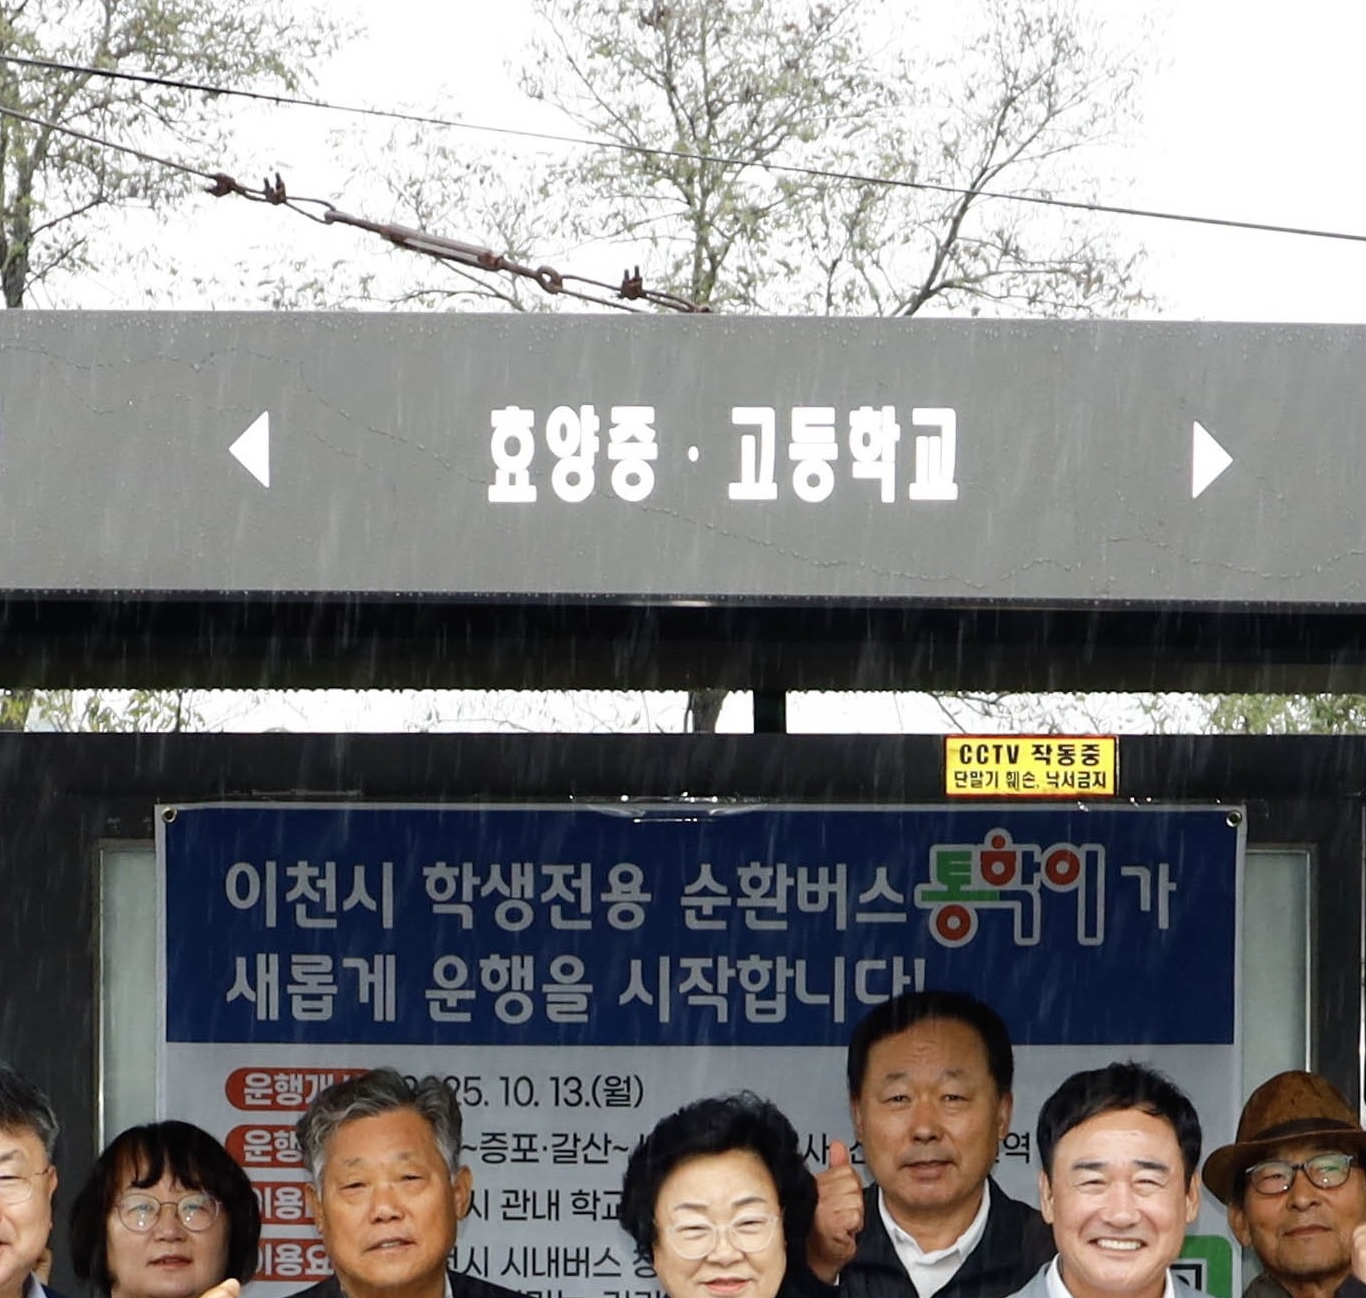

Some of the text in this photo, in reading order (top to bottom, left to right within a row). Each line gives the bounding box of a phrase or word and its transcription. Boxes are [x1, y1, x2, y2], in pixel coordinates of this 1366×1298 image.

[959, 744, 1100, 766] CCTV 작동중
[954, 771, 998, 788] 단말기
[1046, 771, 1106, 789] 낙서금지
[225, 828, 1177, 947] 이천시 학생전용 순환버스 통학이 가
[226, 953, 396, 1022] 새롭게
[425, 953, 594, 1025] 운행을
[243, 1072, 351, 1106] 운행개
[499, 1075, 539, 1107] 10.
[550, 1074, 643, 1108] 13.(월)
[501, 1189, 559, 1221] 관내
[501, 1246, 621, 1278] 시내버스
